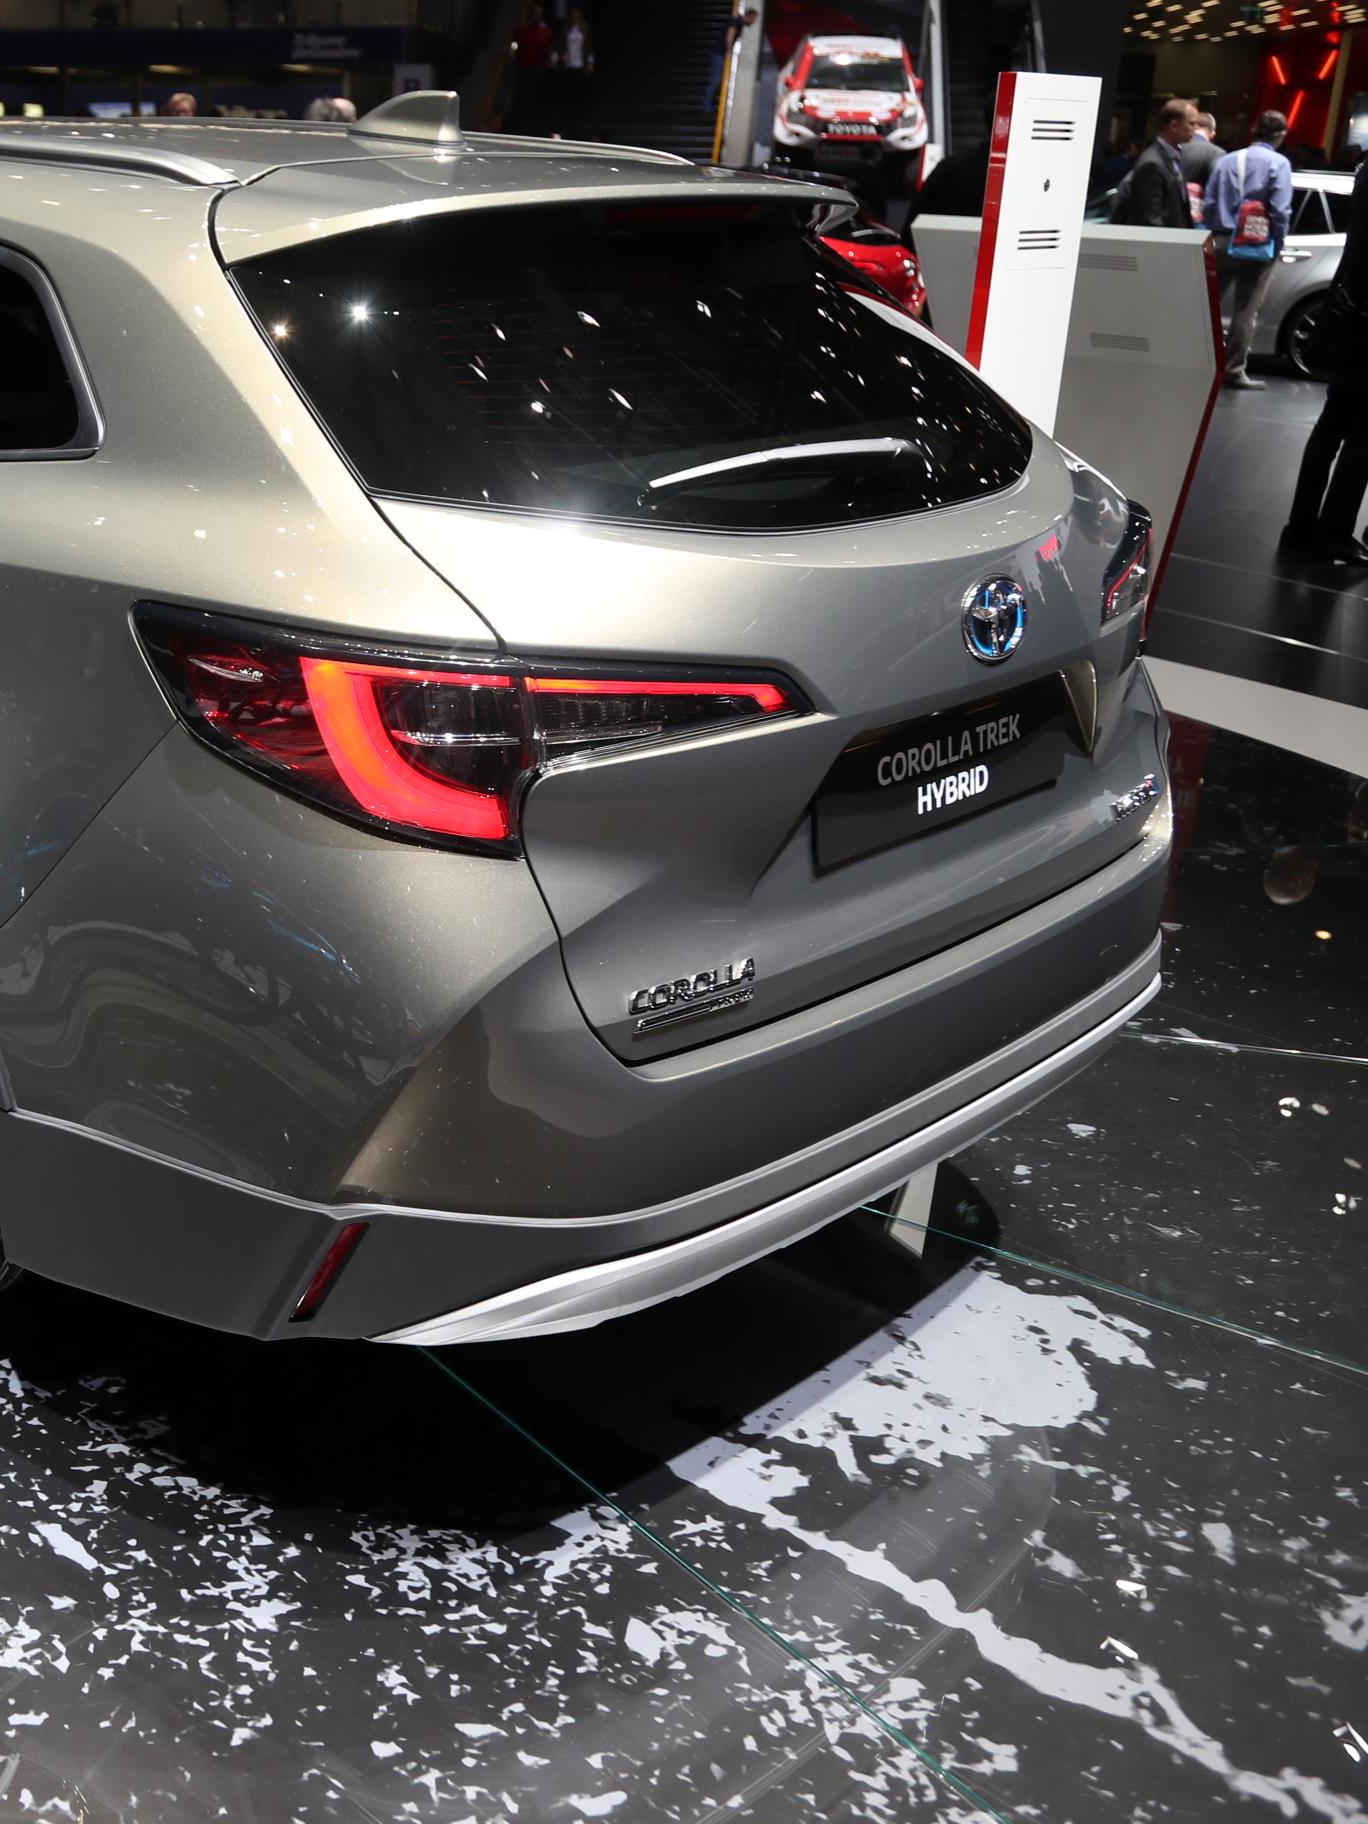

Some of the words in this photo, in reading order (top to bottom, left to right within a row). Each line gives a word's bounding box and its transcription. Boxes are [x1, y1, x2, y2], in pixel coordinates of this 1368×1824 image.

[877, 729, 973, 786] COROLLA
[976, 712, 1022, 751] TREK
[916, 764, 990, 815] HYBRID
[628, 956, 756, 1016] COROLLA
